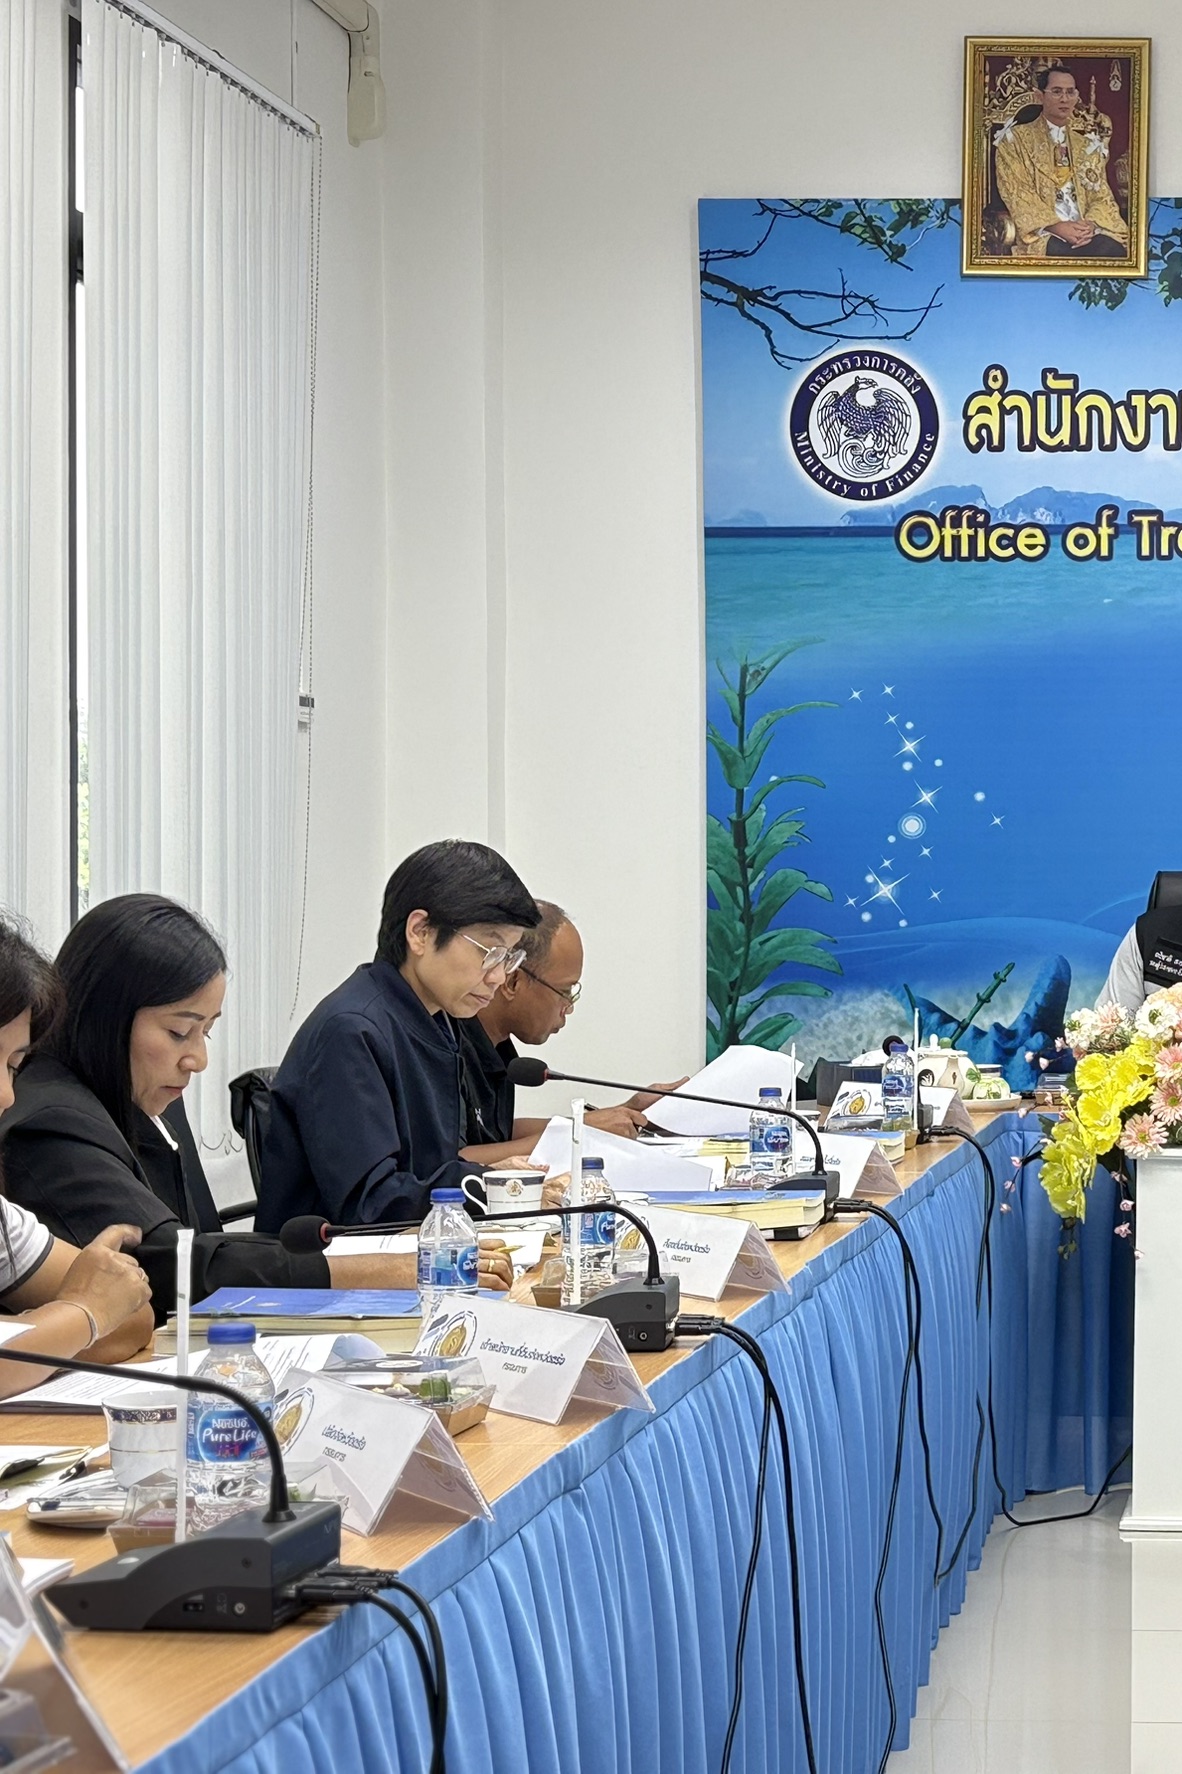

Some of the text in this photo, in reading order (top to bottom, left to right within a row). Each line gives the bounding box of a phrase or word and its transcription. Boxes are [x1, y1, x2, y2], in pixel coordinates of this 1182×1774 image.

[808, 355, 923, 395] กระทรวงการคลัง
[795, 431, 935, 497] Ministry of Finance
[896, 505, 1050, 562] Office
[1062, 505, 1120, 560] of
[202, 1428, 257, 1443] Pure Life
